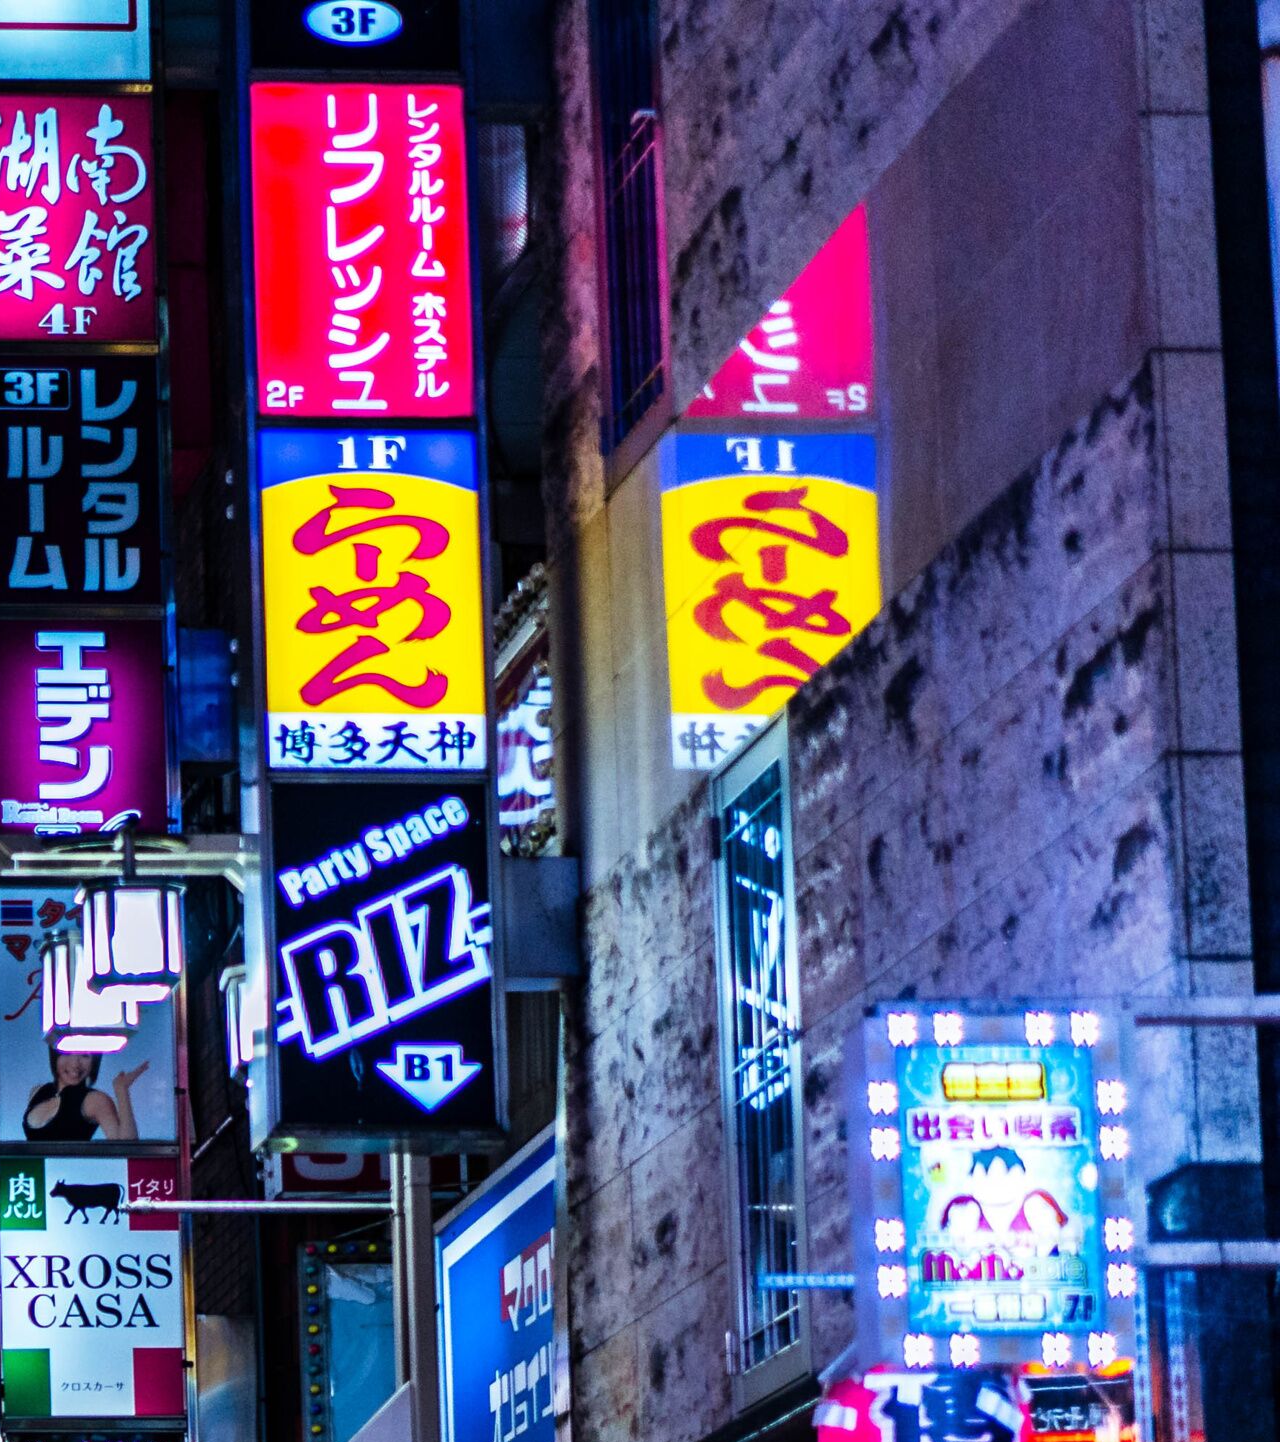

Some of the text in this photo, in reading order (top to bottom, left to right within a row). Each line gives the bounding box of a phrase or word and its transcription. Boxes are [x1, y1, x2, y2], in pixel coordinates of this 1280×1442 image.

[331, 8, 376, 36] 3F
[323, 93, 390, 411] リフレッシュ
[407, 94, 450, 398] レンタルルーム ホステル
[38, 304, 97, 335] 4F
[4, 372, 60, 404] 3F
[265, 380, 304, 408] 2F
[337, 436, 407, 470] 1F
[80, 369, 140, 591] レンタル
[7, 427, 69, 590] ルーム
[292, 484, 451, 708] らーめん
[35, 631, 112, 800] エデン
[273, 720, 476, 766] 博多天神
[279, 796, 470, 905] Party Space
[404, 1052, 453, 1082] B1
[8, 1173, 35, 1201] 肉
[130, 1178, 174, 1195] イタリ
[3, 1202, 42, 1219] バル
[4, 1253, 173, 1289] XROSS
[28, 1293, 159, 1329] CASA
